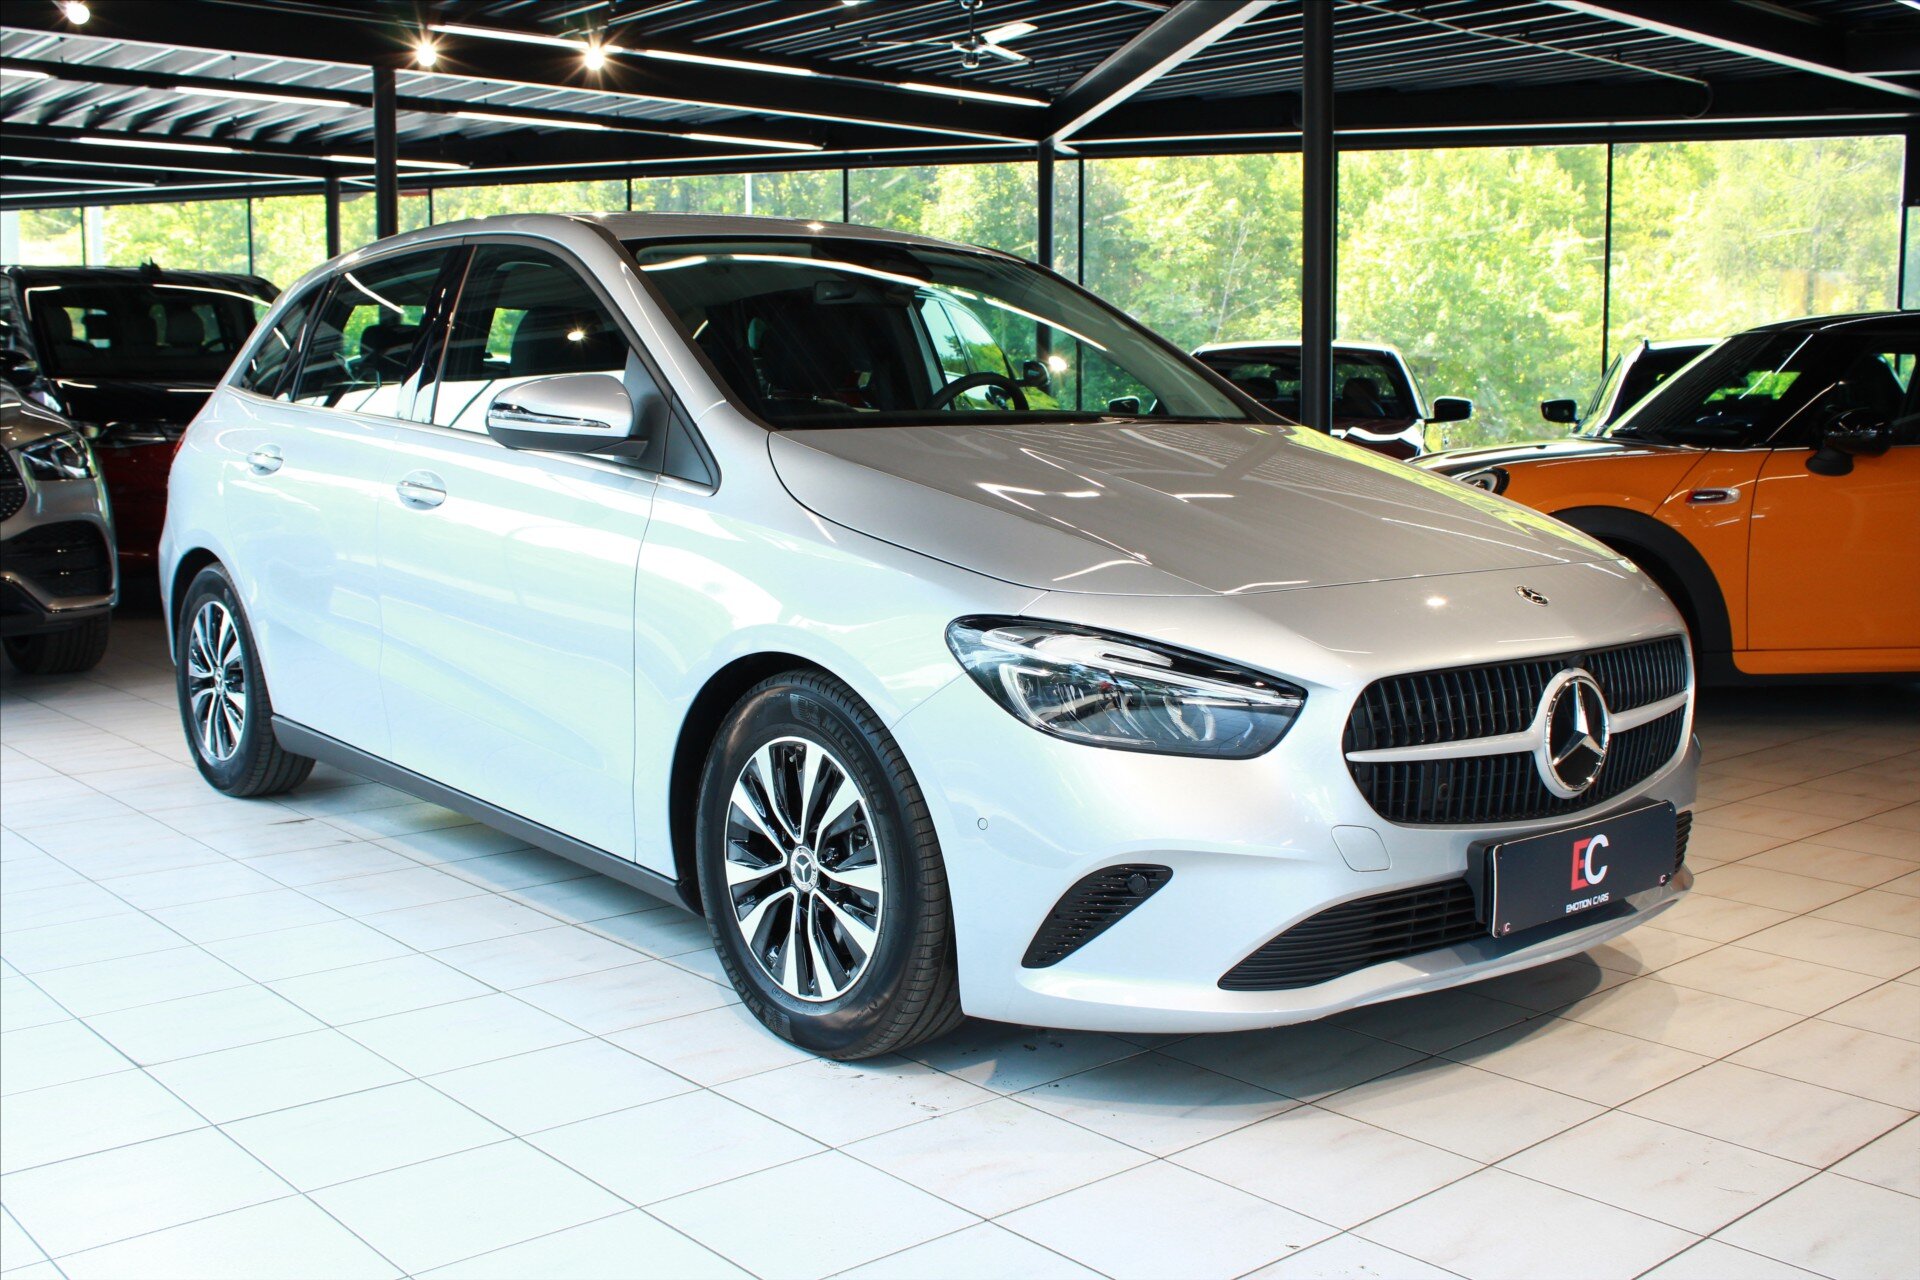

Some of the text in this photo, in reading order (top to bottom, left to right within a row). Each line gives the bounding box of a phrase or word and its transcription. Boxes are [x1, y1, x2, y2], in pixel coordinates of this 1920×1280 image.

[1571, 834, 1609, 890] EC
[1565, 892, 1610, 914] EMOTION CARS
